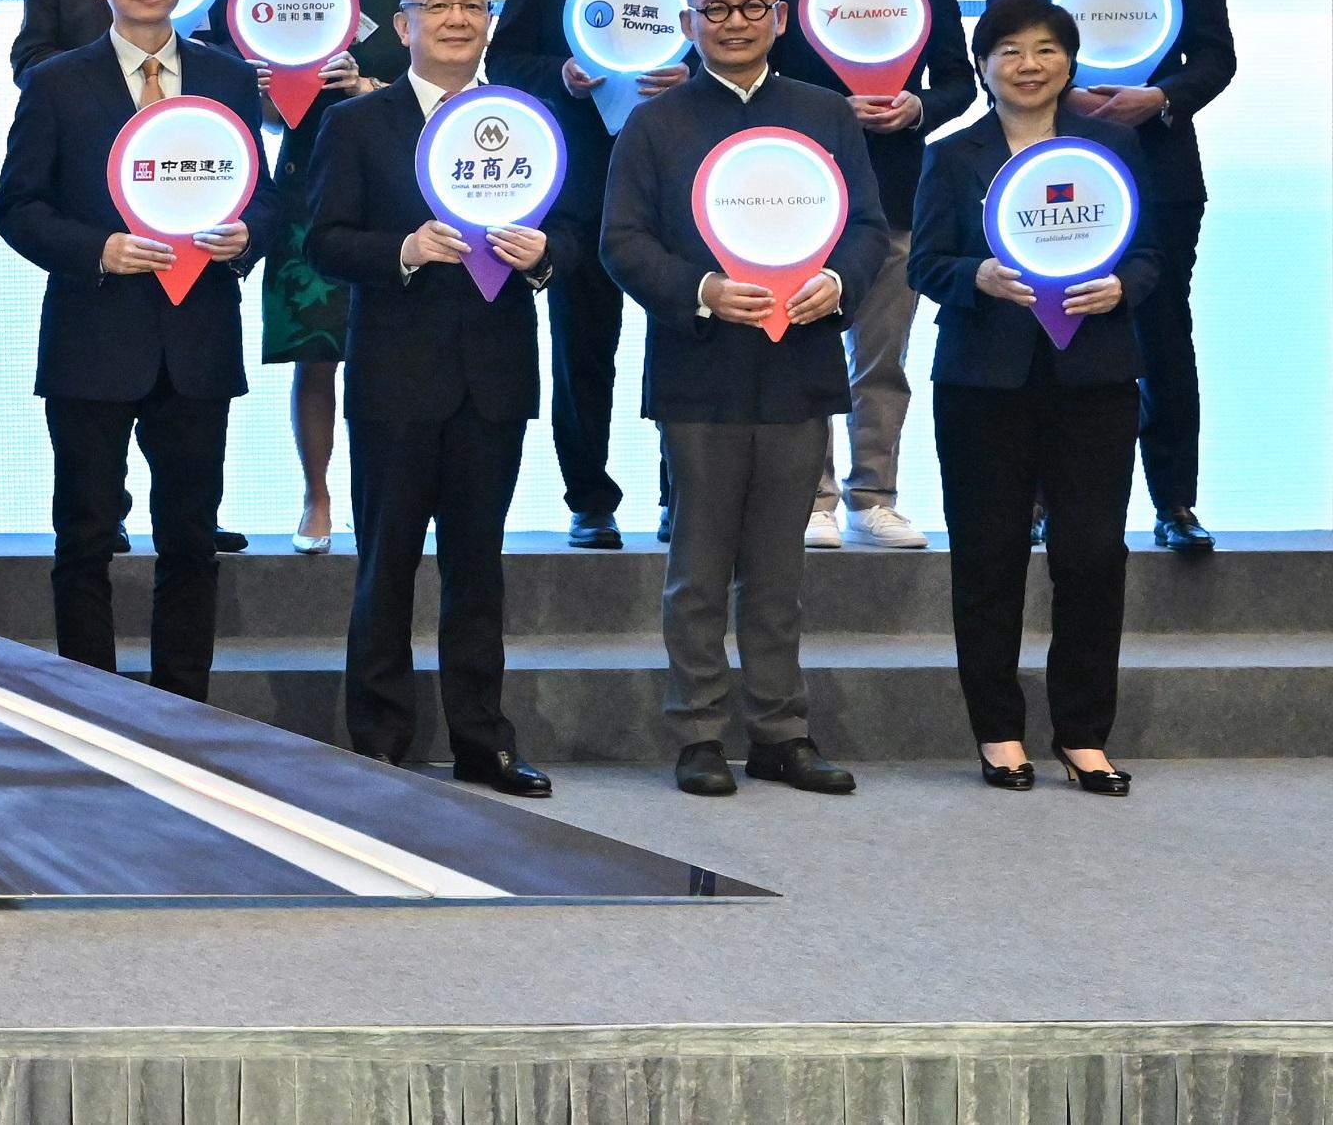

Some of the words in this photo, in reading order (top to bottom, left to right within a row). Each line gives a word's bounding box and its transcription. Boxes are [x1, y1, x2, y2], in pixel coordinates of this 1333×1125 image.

[302, 2, 335, 10] GROUP
[622, 3, 659, 19] 煤氣
[840, 7, 908, 19] LALAMOVE
[1091, 11, 1158, 21] PENINSULA
[621, 17, 675, 34] Towngas
[451, 157, 532, 181] 招商局
[715, 196, 784, 206] SHANGRI-LA
[787, 196, 826, 206] GROUP
[1016, 203, 1105, 228] WHARF
[1035, 234, 1073, 243] Established
